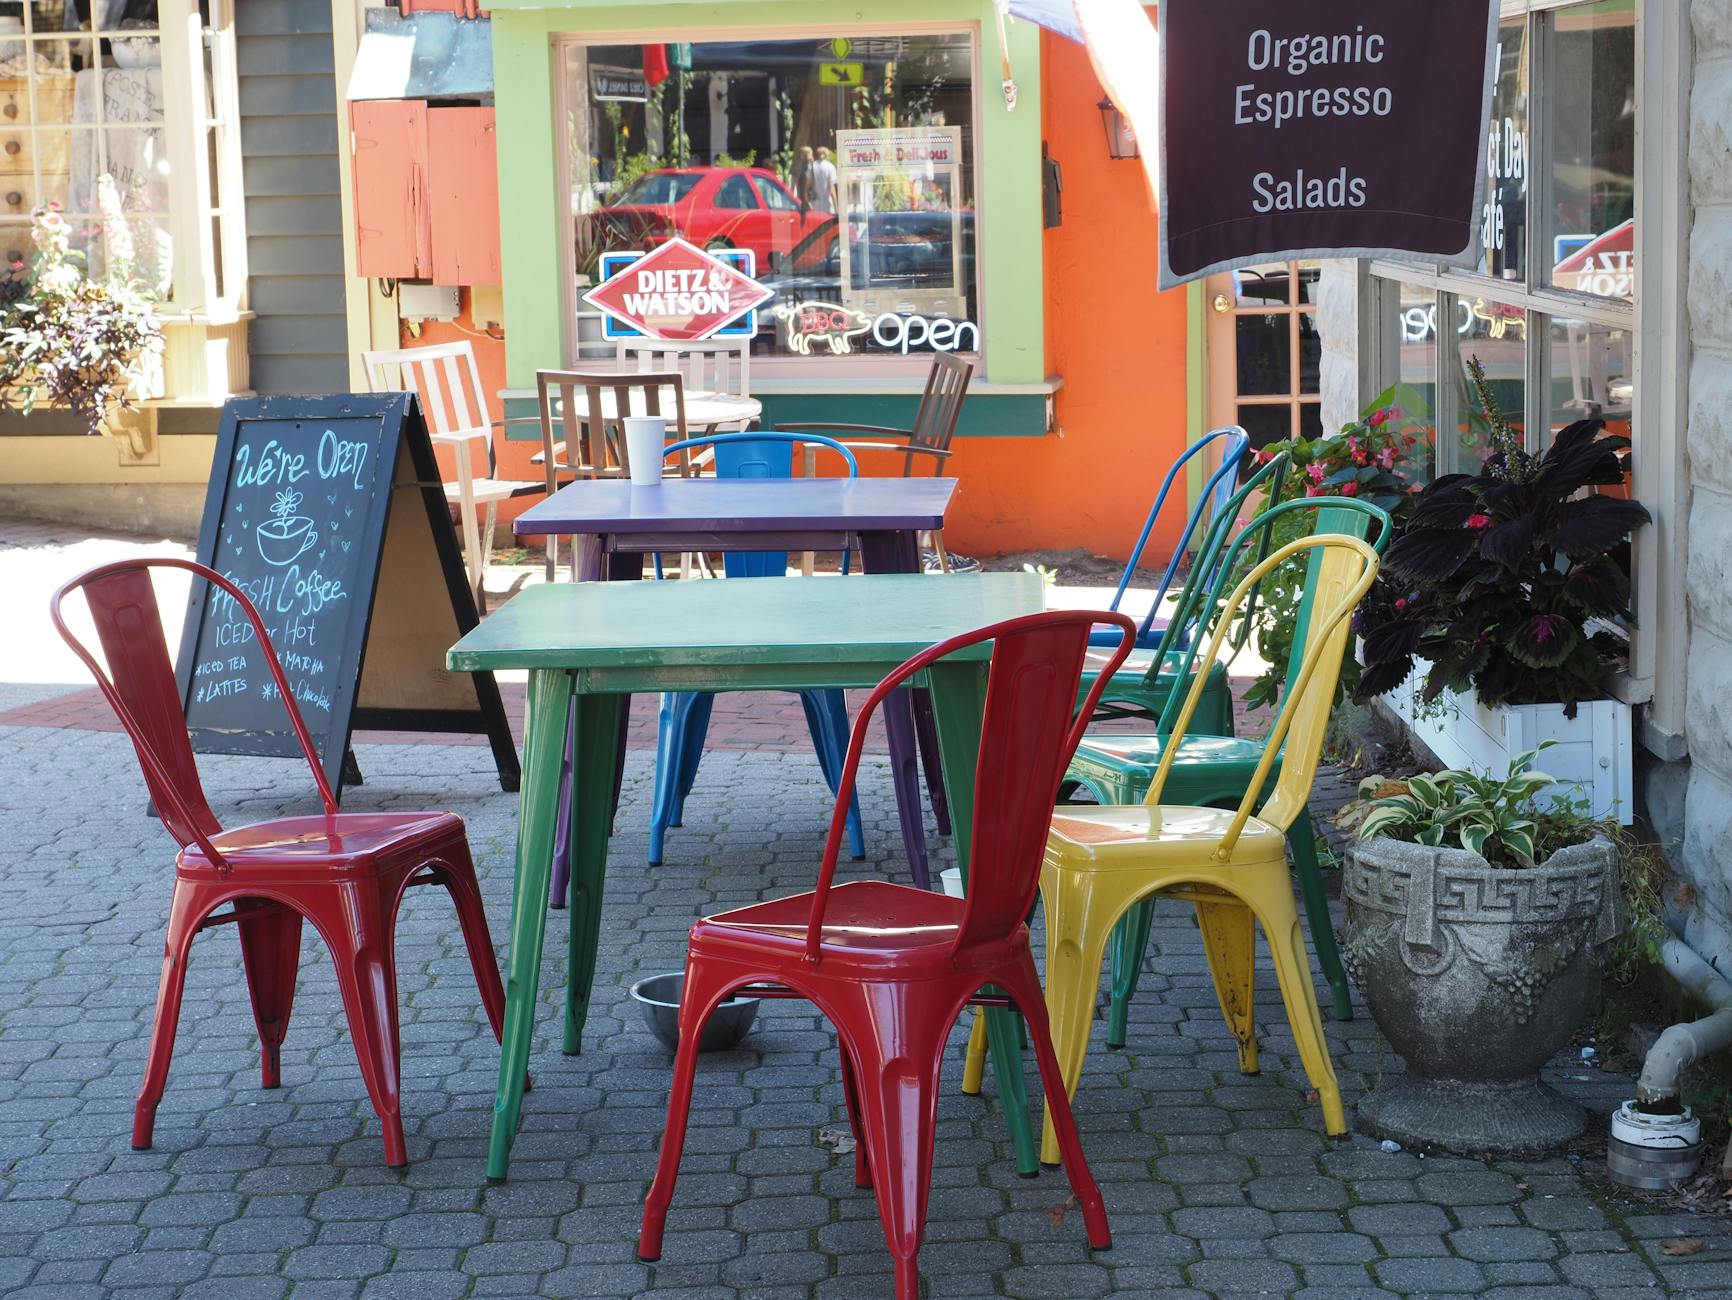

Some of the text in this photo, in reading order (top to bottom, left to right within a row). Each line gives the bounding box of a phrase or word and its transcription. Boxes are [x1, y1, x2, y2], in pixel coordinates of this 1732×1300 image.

[1247, 25, 1385, 76] Organic
[1234, 83, 1393, 129] Espresso
[896, 147, 948, 162] Deliious
[1251, 166, 1367, 213] Salads
[1481, 187, 1504, 250] afé
[637, 269, 728, 293] DIETZ &
[623, 291, 730, 316] WATSON
[799, 311, 849, 334] BBQ
[236, 439, 310, 488] We're
[276, 564, 347, 616] Coffee
[215, 622, 255, 648] ICED
[284, 615, 318, 646] Hot
[227, 655, 247, 671] TEA
[285, 650, 325, 676] MATCHA
[206, 678, 248, 703] LATTES
[274, 681, 295, 699] Ht
